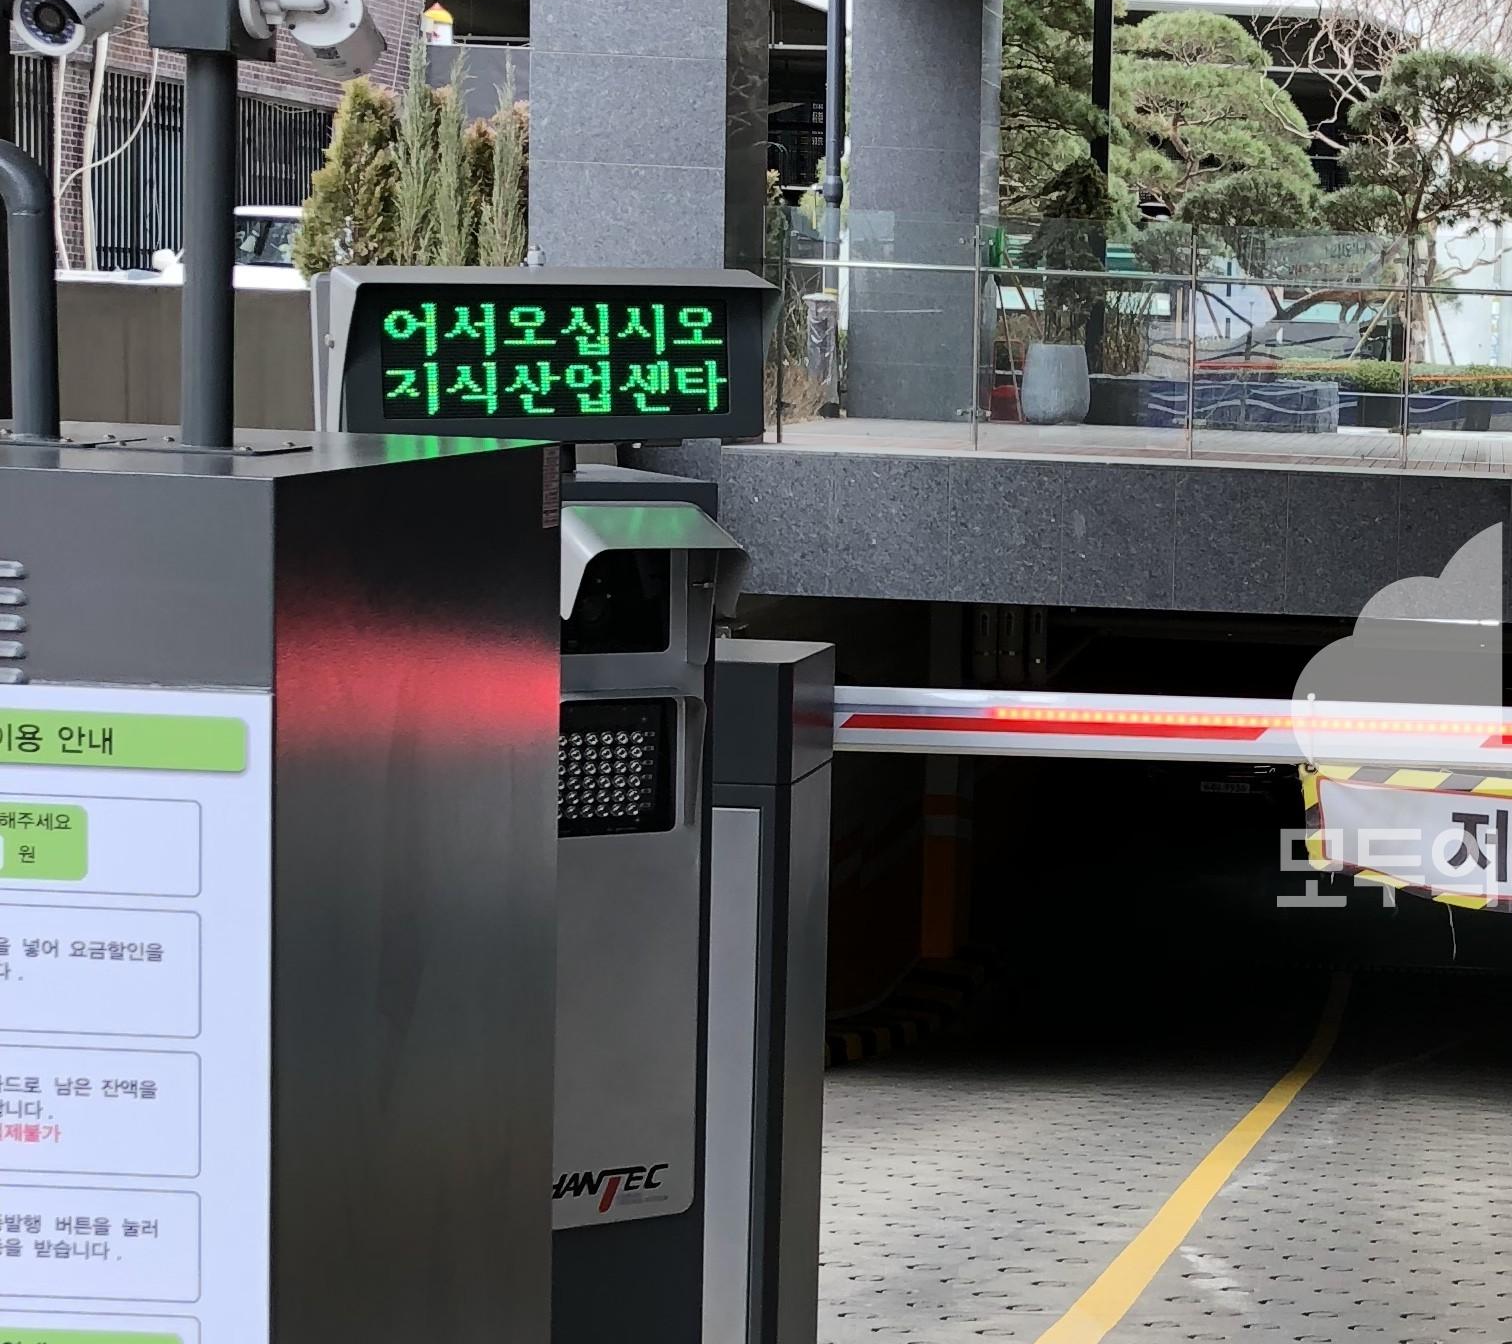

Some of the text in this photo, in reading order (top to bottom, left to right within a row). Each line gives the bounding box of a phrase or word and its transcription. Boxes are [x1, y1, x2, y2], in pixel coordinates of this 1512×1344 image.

[383, 302, 722, 356] 어서오십시오
[58, 726, 114, 756] 안내
[18, 845, 36, 864] 원
[23, 938, 59, 958] 넣어
[69, 941, 164, 962] 요금할인을
[0, 1076, 158, 1099] 드로 남은 잔액을
[0, 1123, 61, 1144] 제불가
[0, 1214, 158, 1238] 발행 버튼을 눌러
